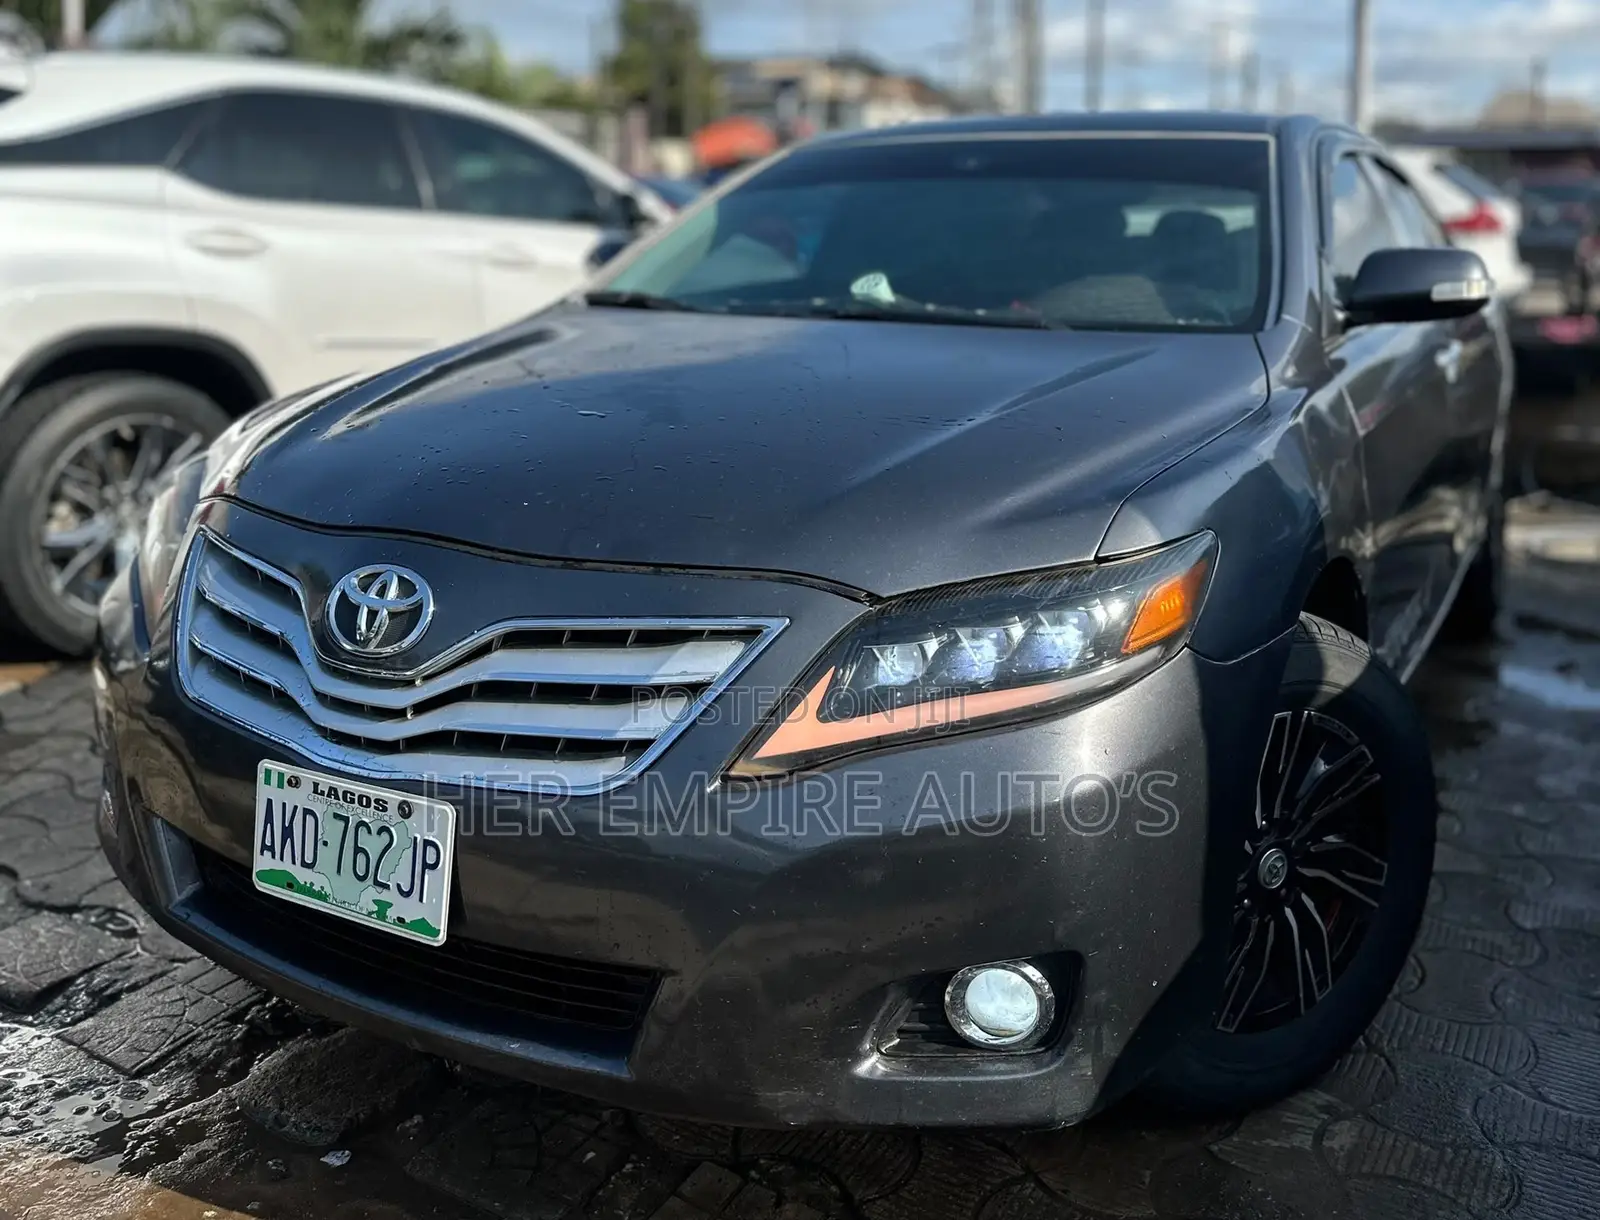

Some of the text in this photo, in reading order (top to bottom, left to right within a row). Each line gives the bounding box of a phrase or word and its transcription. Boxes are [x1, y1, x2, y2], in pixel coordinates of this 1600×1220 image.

[307, 793, 334, 808] CENTRE
[346, 804, 394, 823] EXCELLENCE
[312, 781, 389, 813] LAGOS
